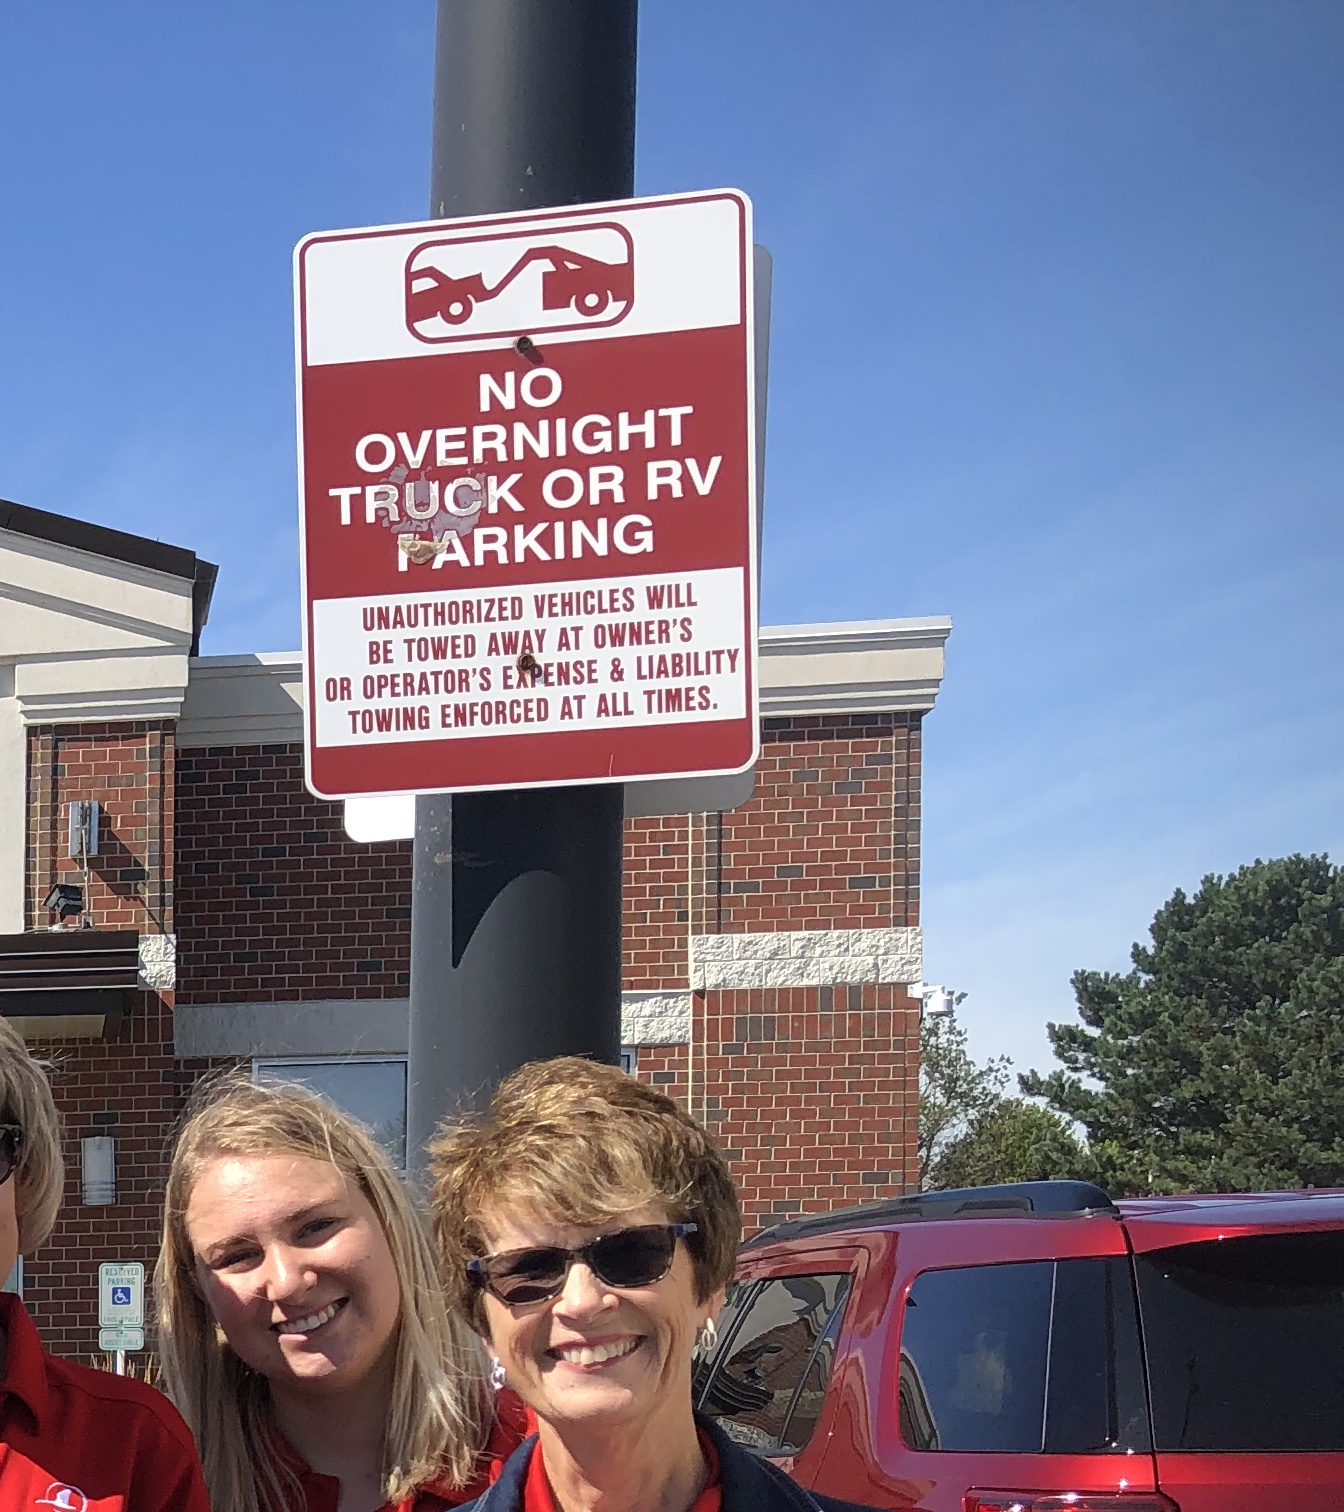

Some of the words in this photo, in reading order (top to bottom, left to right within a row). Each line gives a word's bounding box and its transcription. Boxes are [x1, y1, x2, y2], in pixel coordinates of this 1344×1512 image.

[479, 367, 563, 412] NO
[355, 405, 693, 473] OVERNIGHT
[329, 471, 524, 526] TRUCK
[541, 465, 625, 508] OR
[647, 455, 723, 496] RV
[362, 595, 523, 632] UNAUTHORIZED
[535, 588, 635, 621] VEHICLES
[647, 582, 698, 611] WILL
[368, 640, 394, 665] BE
[403, 631, 476, 662] TOWED
[487, 627, 546, 656] AWAY
[557, 624, 583, 653] AT
[594, 617, 693, 649] OWNER'S
[325, 676, 351, 702] OR
[362, 666, 492, 700] OPERATOR'S
[502, 659, 598, 690] EXPENSE
[611, 657, 624, 681] &
[636, 648, 739, 680] LIABILITY
[349, 704, 430, 736] TOWING
[440, 698, 549, 729] ENFORCED
[560, 696, 586, 720] AT
[596, 691, 634, 719] ALL
[643, 686, 718, 716] TIMES.
